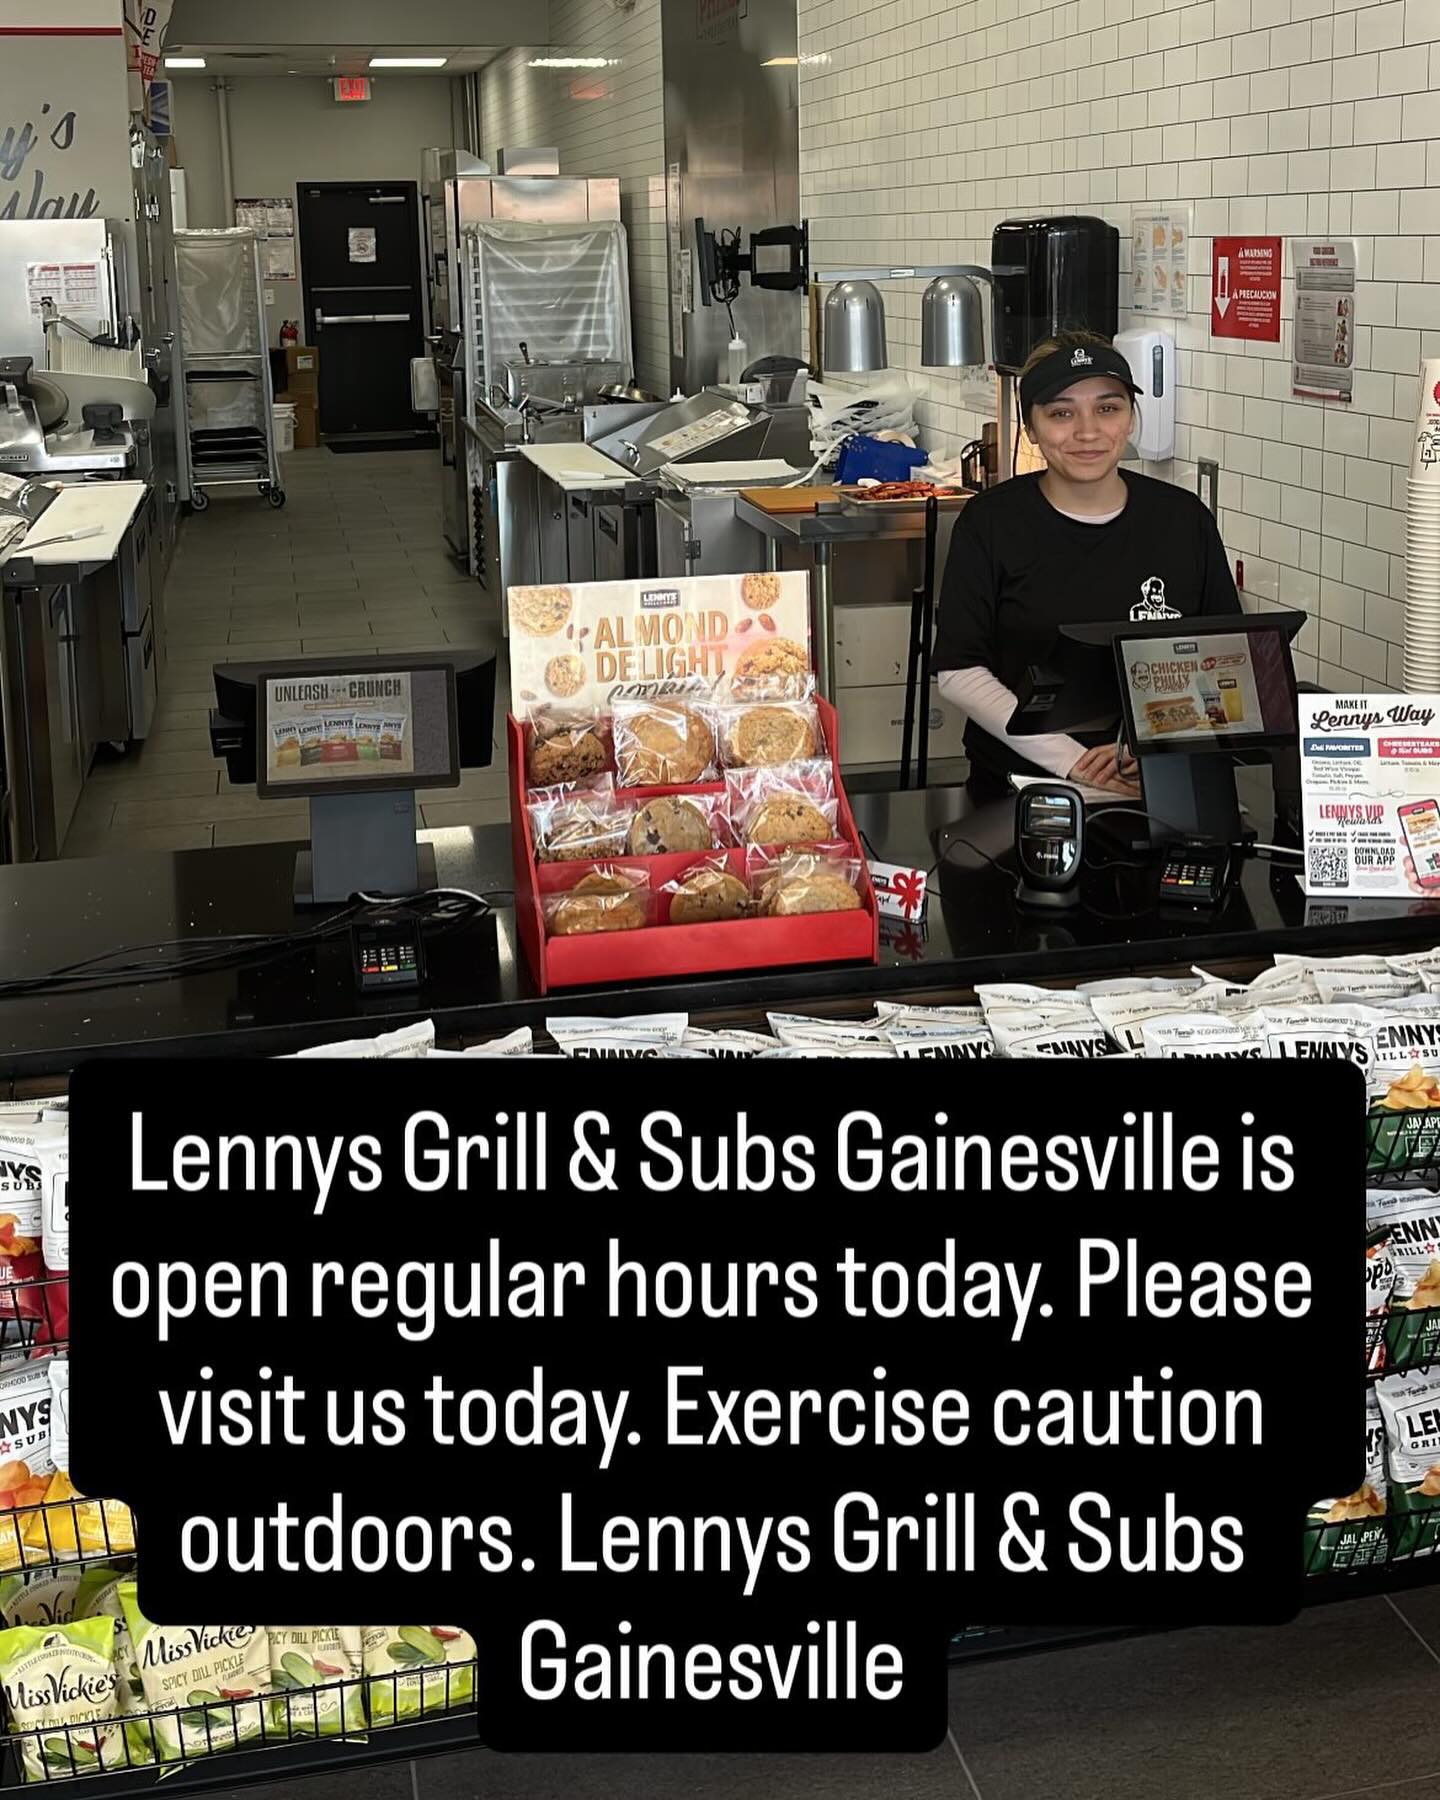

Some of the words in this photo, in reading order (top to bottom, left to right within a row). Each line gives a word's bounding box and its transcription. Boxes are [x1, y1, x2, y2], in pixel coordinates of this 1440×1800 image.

[1244, 249, 1272, 258] WARNING
[594, 612, 729, 650] ALMOND
[596, 646, 728, 682] DELIGHT
[1151, 661, 1198, 674] CHICKEN
[275, 684, 329, 702] UNLEASH
[349, 679, 401, 698] CRUNCH
[1335, 700, 1358, 710] MAKE
[1360, 700, 1368, 710] IT
[1310, 711, 1384, 732] Lennys
[1387, 704, 1436, 726] Way
[1319, 804, 1362, 820] LENNYS
[1364, 803, 1384, 818] VIP
[1354, 847, 1396, 856] DOWNLOAD
[1354, 856, 1374, 865] OUR
[1376, 856, 1396, 865] APP
[1376, 1024, 1440, 1049] ENNY
[1036, 1038, 1107, 1059] ENNYS
[1278, 1040, 1369, 1065] LENNYS
[1388, 1219, 1440, 1245] ENN
[1390, 1245, 1426, 1259] RILL
[14, 1428, 52, 1449] SUB
[142, 1636, 192, 1670] Miss
[187, 1625, 257, 1653] Vickies
[268, 1630, 287, 1646] PICY
[290, 1629, 308, 1644] DILL
[311, 1627, 339, 1643] PICKLE
[162, 1671, 188, 1691] SPICY
[192, 1663, 211, 1682] DILL
[213, 1653, 245, 1677] PICKLE
[5, 1681, 51, 1710] Miss
[43, 1665, 120, 1704] Vickie's
